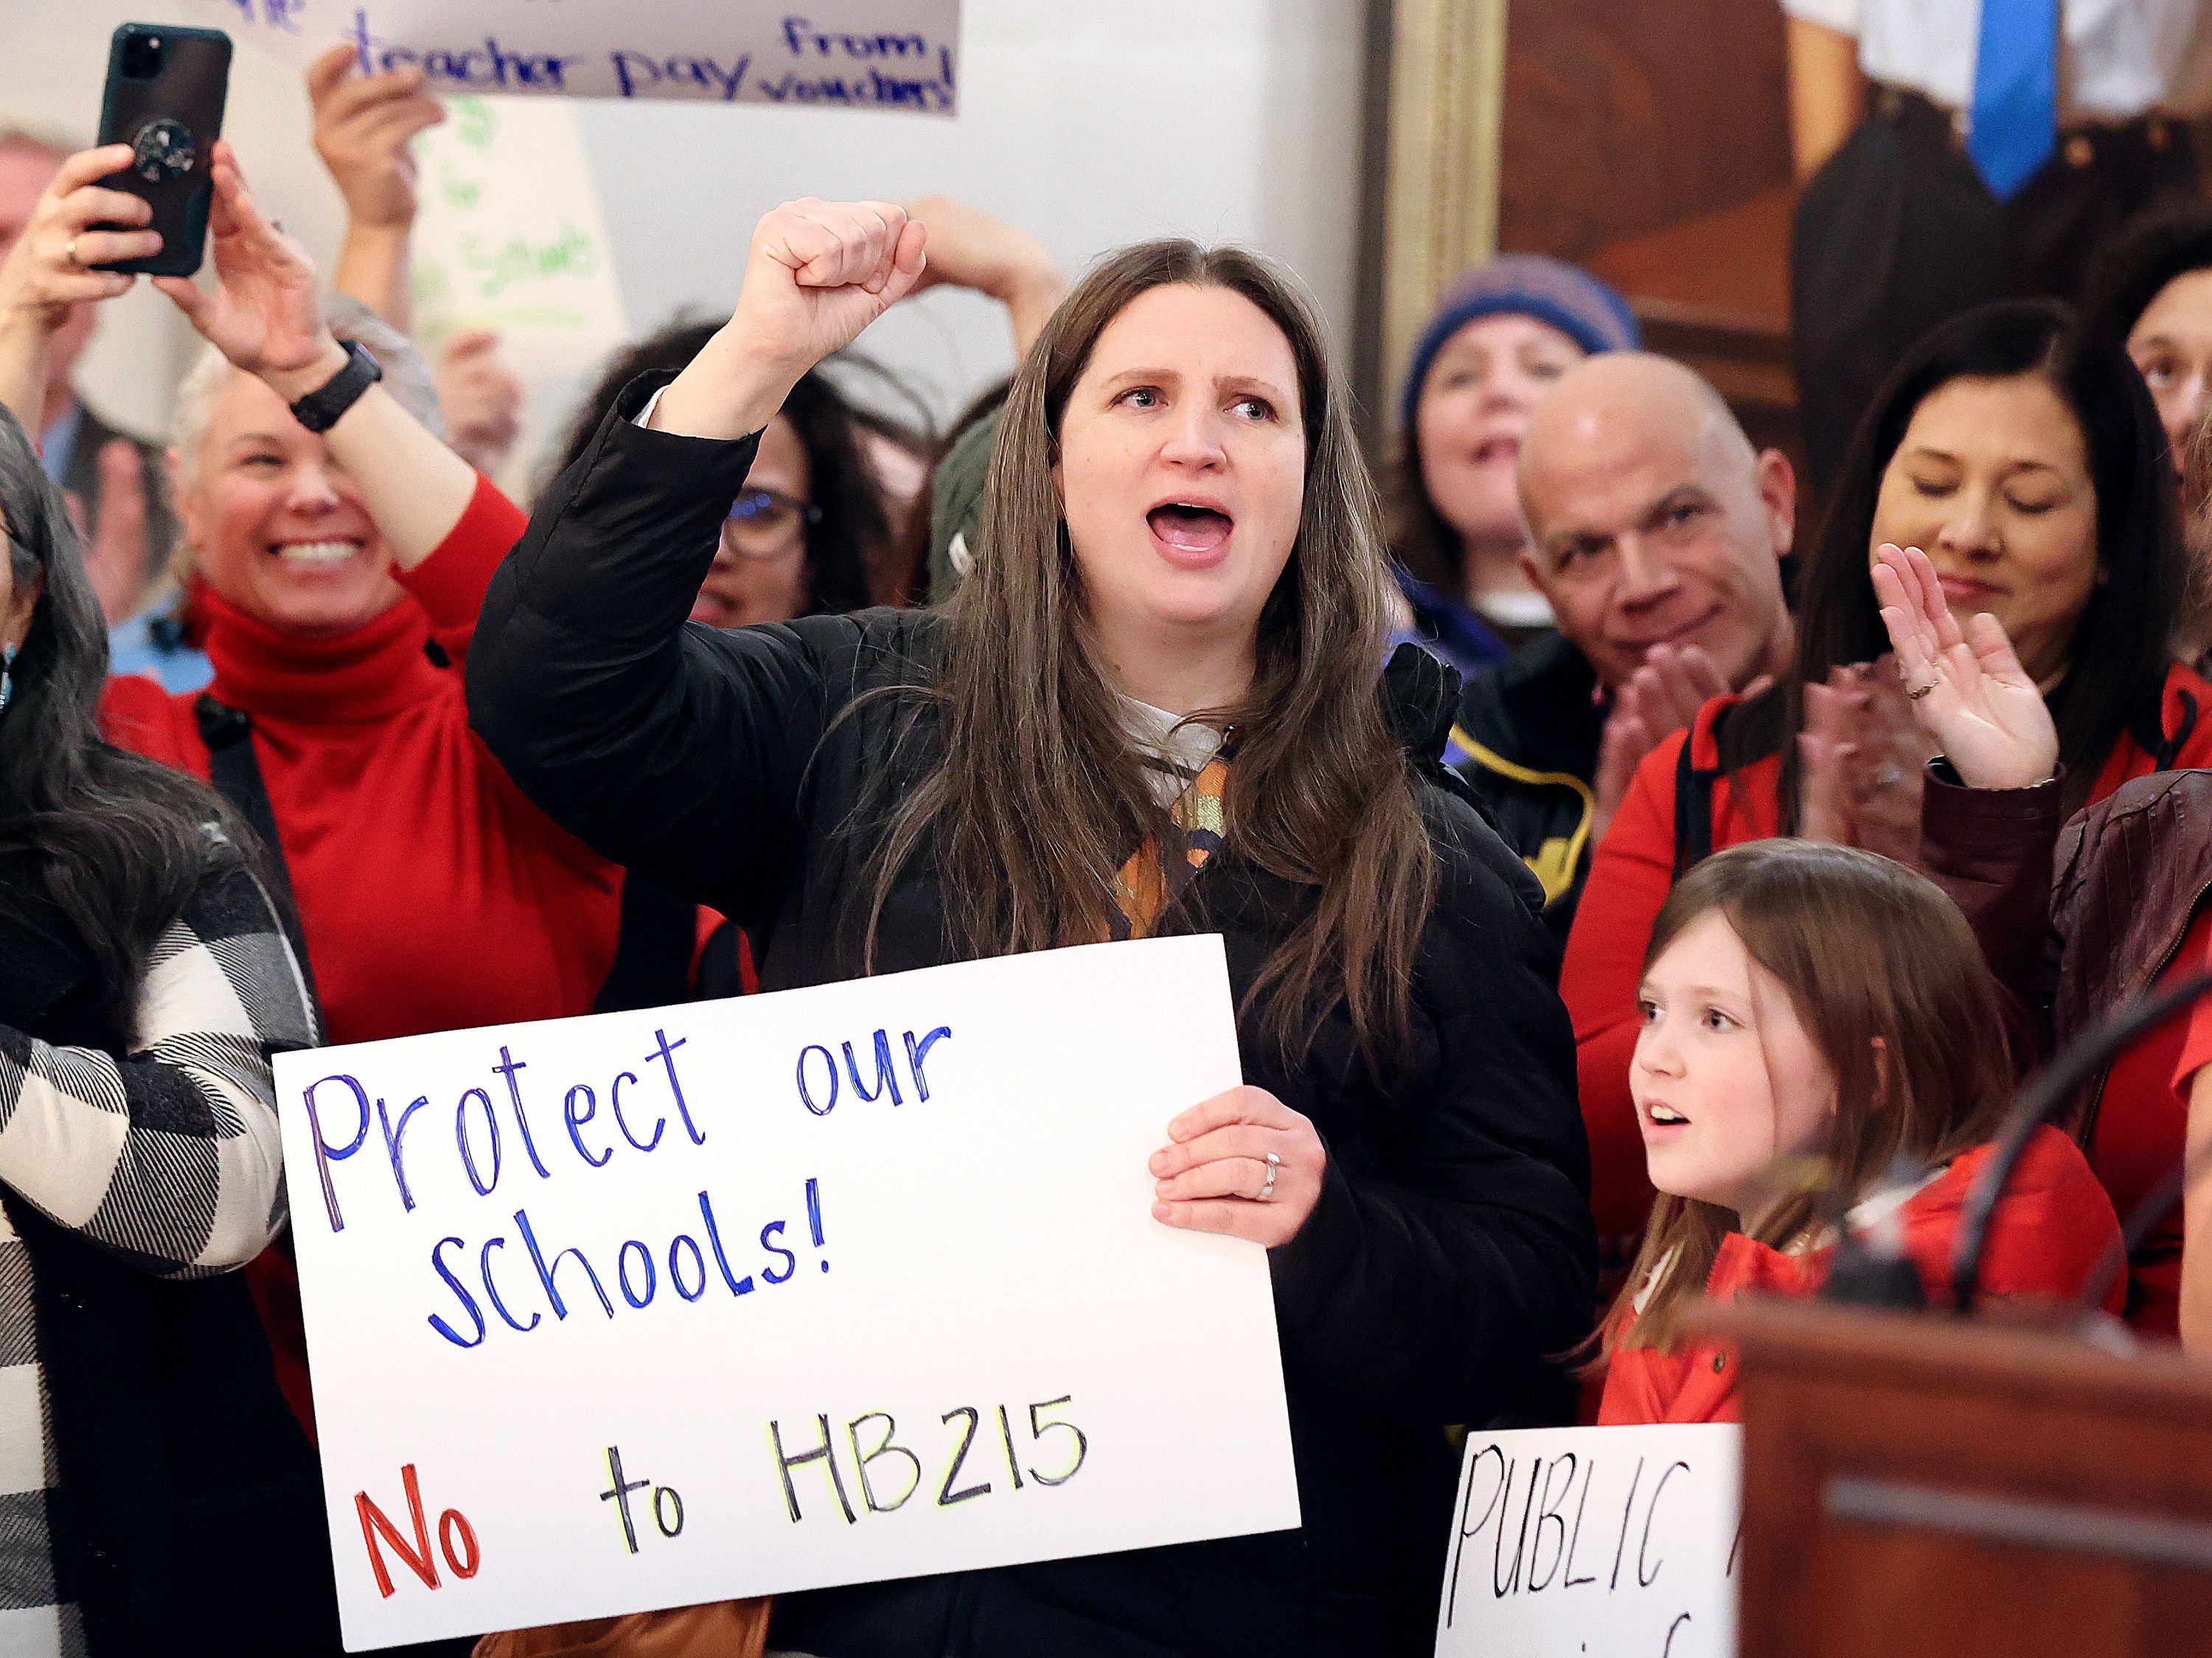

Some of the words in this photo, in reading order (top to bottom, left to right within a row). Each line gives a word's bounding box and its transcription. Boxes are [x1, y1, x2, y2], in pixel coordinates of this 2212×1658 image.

[609, 49, 750, 101] pay
[782, 15, 925, 59] from
[303, 1029, 706, 1233] Protect
[796, 1027, 951, 1116] our
[355, 1463, 480, 1600] No
[600, 1446, 684, 1553] to
[771, 1395, 1087, 1525] HB215
[1447, 1443, 1691, 1629] PUBLIC
